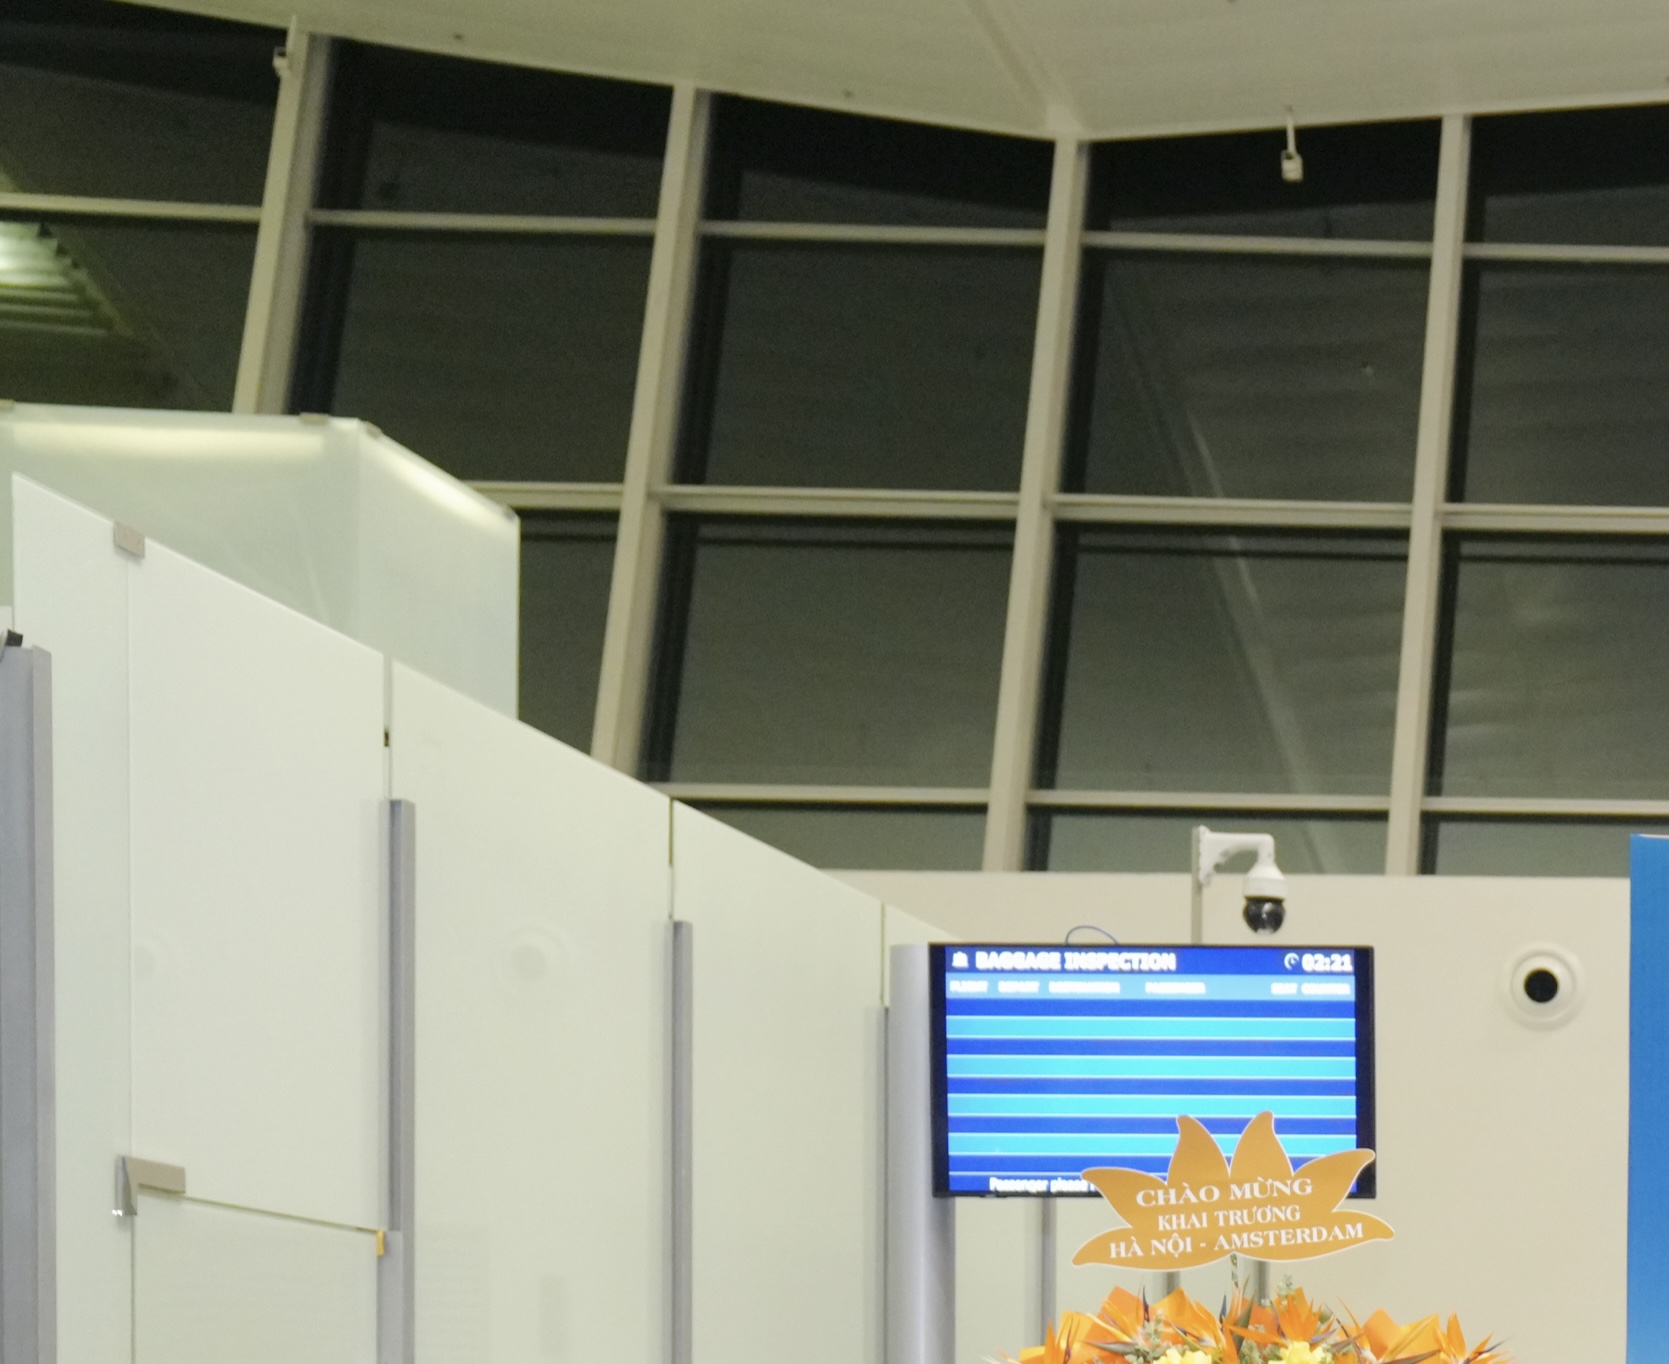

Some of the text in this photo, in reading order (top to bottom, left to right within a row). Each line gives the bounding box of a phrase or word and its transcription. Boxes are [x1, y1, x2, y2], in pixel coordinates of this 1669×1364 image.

[975, 951, 1176, 972] BAGGAGE INSPECTION
[1136, 1177, 1313, 1207] CHÀO MỪNG
[1157, 1205, 1301, 1231] KHAI TRƯƠNG
[1109, 1236, 1144, 1258] HÀ
[1150, 1233, 1193, 1258] NỘI
[1213, 1223, 1364, 1251] AMSTERDAM
